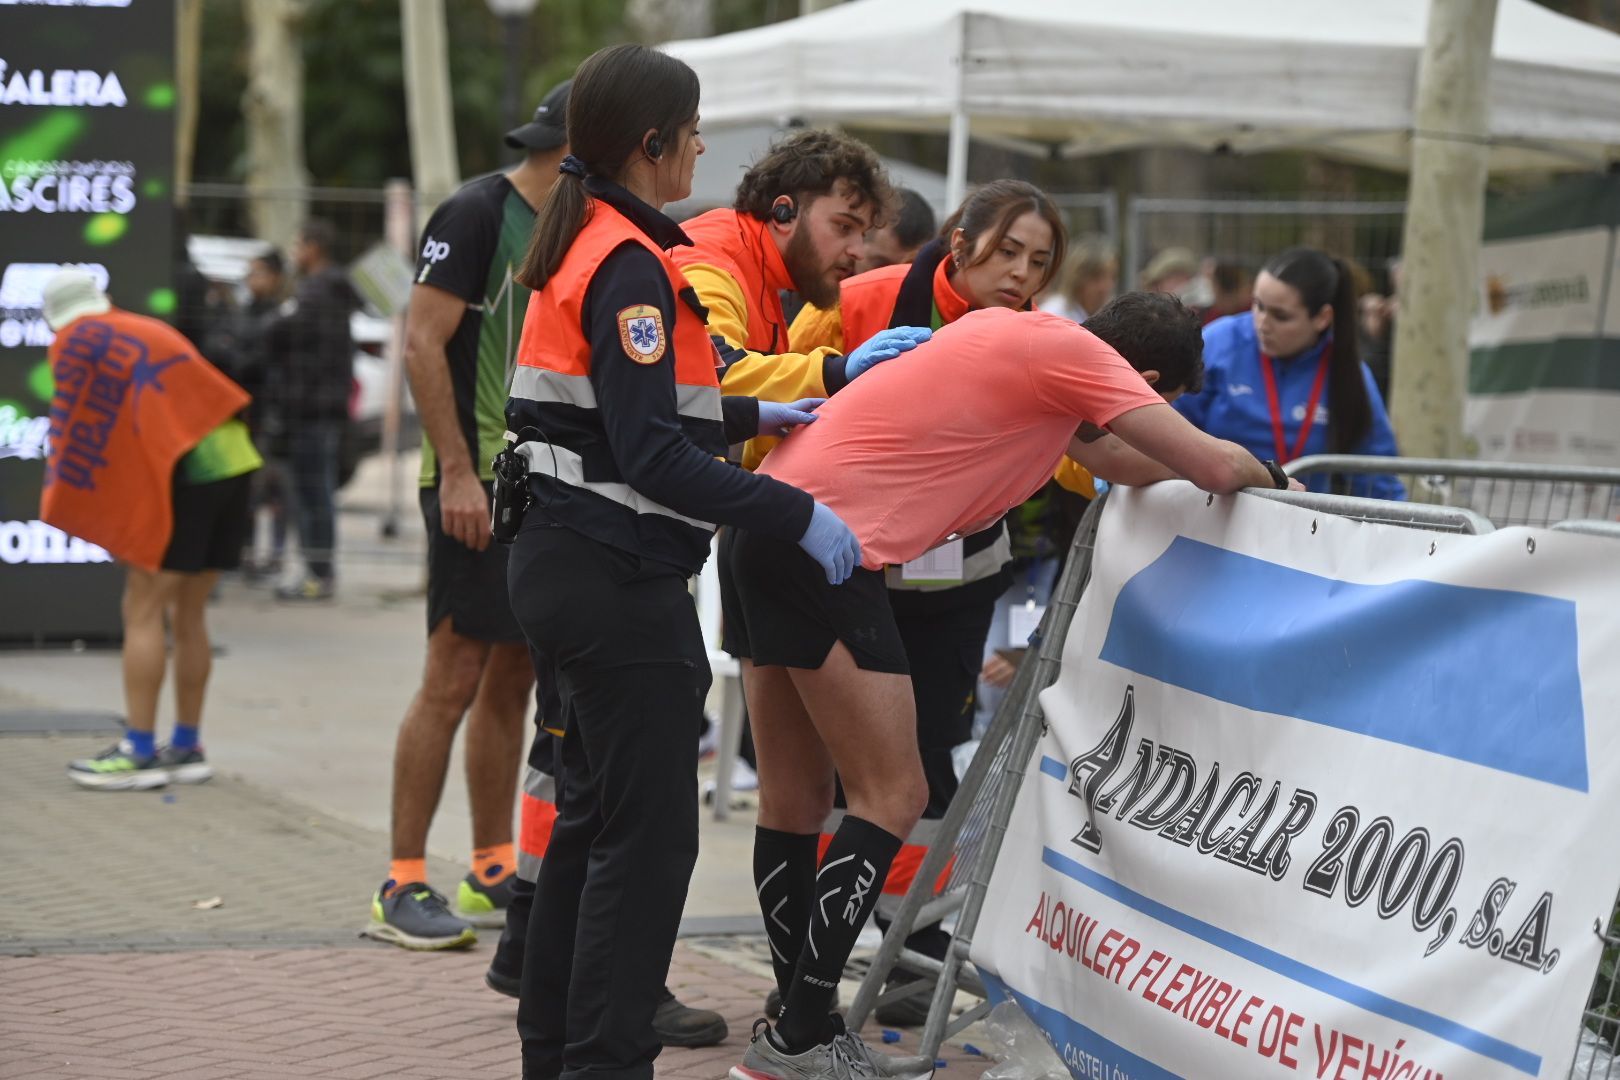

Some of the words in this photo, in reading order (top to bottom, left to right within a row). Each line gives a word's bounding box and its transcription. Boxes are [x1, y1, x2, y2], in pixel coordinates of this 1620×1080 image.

[422, 236, 450, 264] bp
[619, 317, 643, 361] TRANSPORTE
[652, 314, 664, 360] SANITARIO
[1069, 685, 1317, 881] ANDACAR
[1302, 805, 1465, 958] 2000,
[1459, 877, 1560, 975] S.A.
[842, 858, 877, 926] 2XU
[1025, 891, 1141, 985] ALQUILER
[1128, 950, 1265, 1047] FLEXIBLE
[1258, 1005, 1305, 1070] DE
